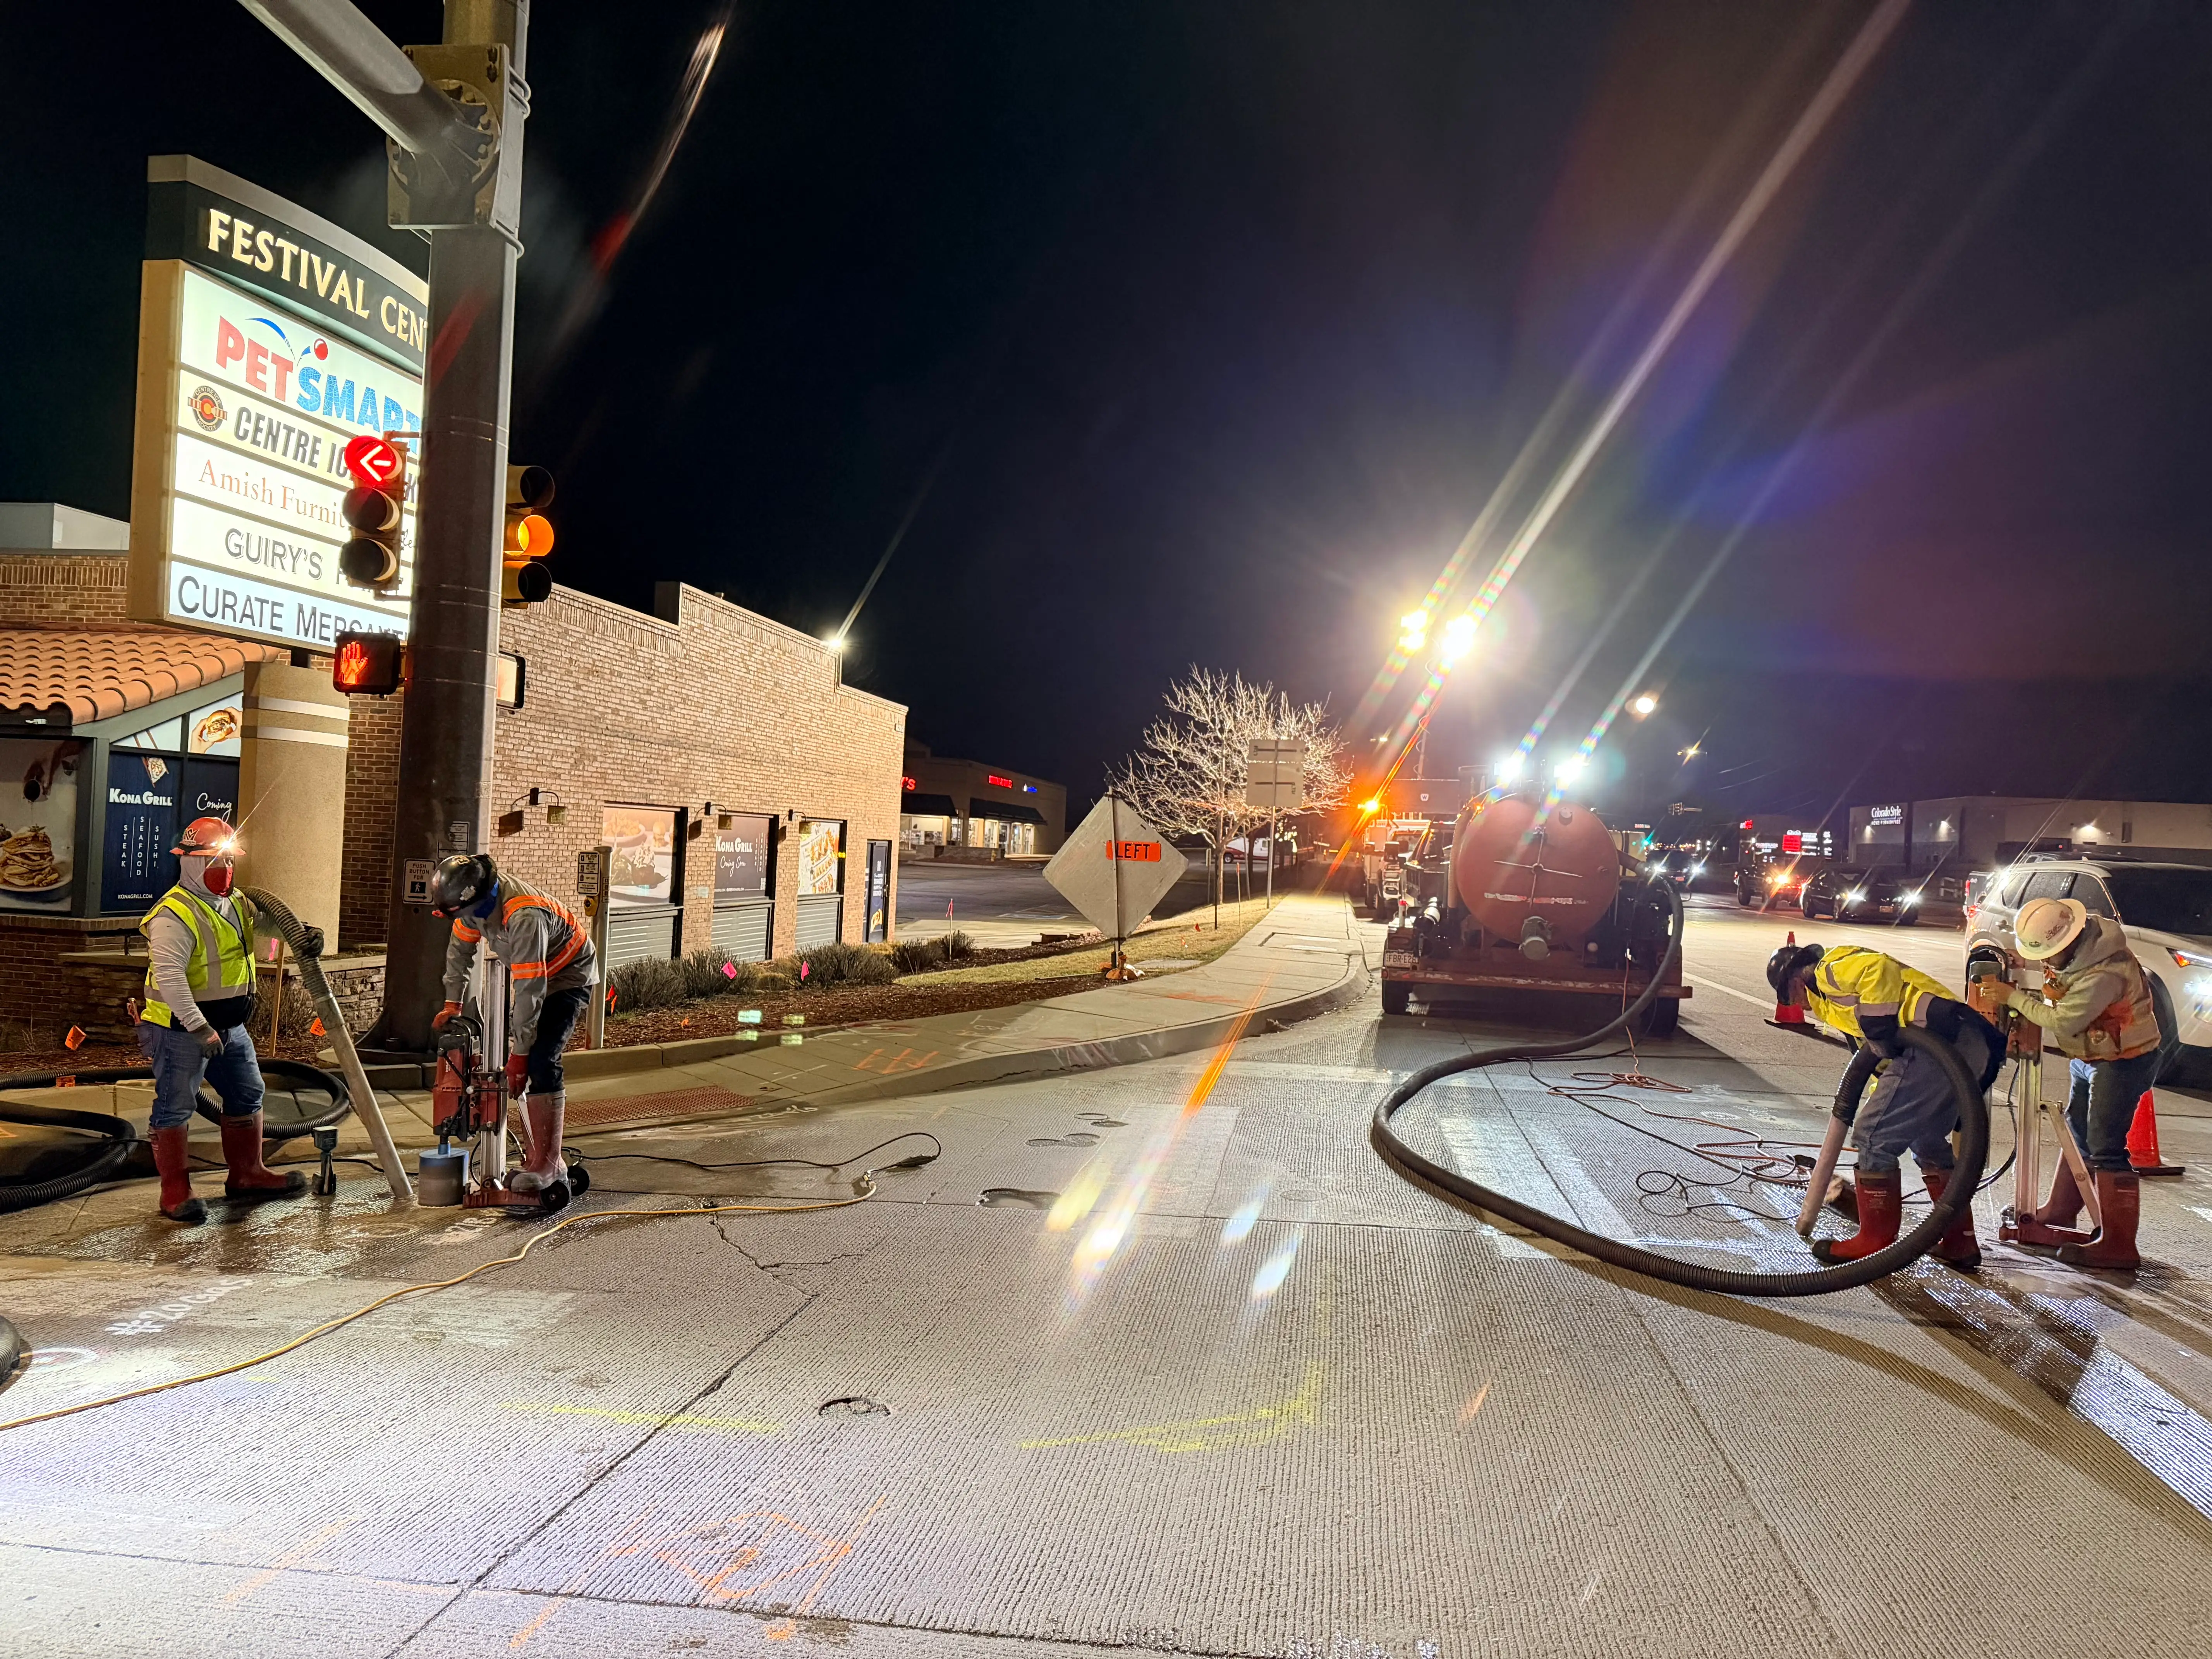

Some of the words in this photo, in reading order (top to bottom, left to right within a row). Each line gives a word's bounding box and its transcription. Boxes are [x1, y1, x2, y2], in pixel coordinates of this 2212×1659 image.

[208, 209, 369, 319] FESTIVAL
[381, 296, 428, 352] CEN
[216, 315, 421, 455] PETSMART
[197, 418, 217, 431] HOCKEY
[234, 407, 321, 468] CENTRE
[327, 443, 348, 478] IC
[199, 459, 274, 505] Amish
[280, 485, 346, 529] Furnit
[225, 528, 323, 580] GUIRY'S
[178, 575, 284, 632] CURATE
[109, 788, 141, 804] KONA
[143, 791, 172, 806] GRILL
[196, 793, 232, 823] Coming
[1872, 806, 1890, 817] Colorado
[716, 836, 734, 852] KONA
[735, 837, 752, 853] GRILL
[1116, 842, 1151, 859] LEFT
[720, 855, 735, 877] Coming
